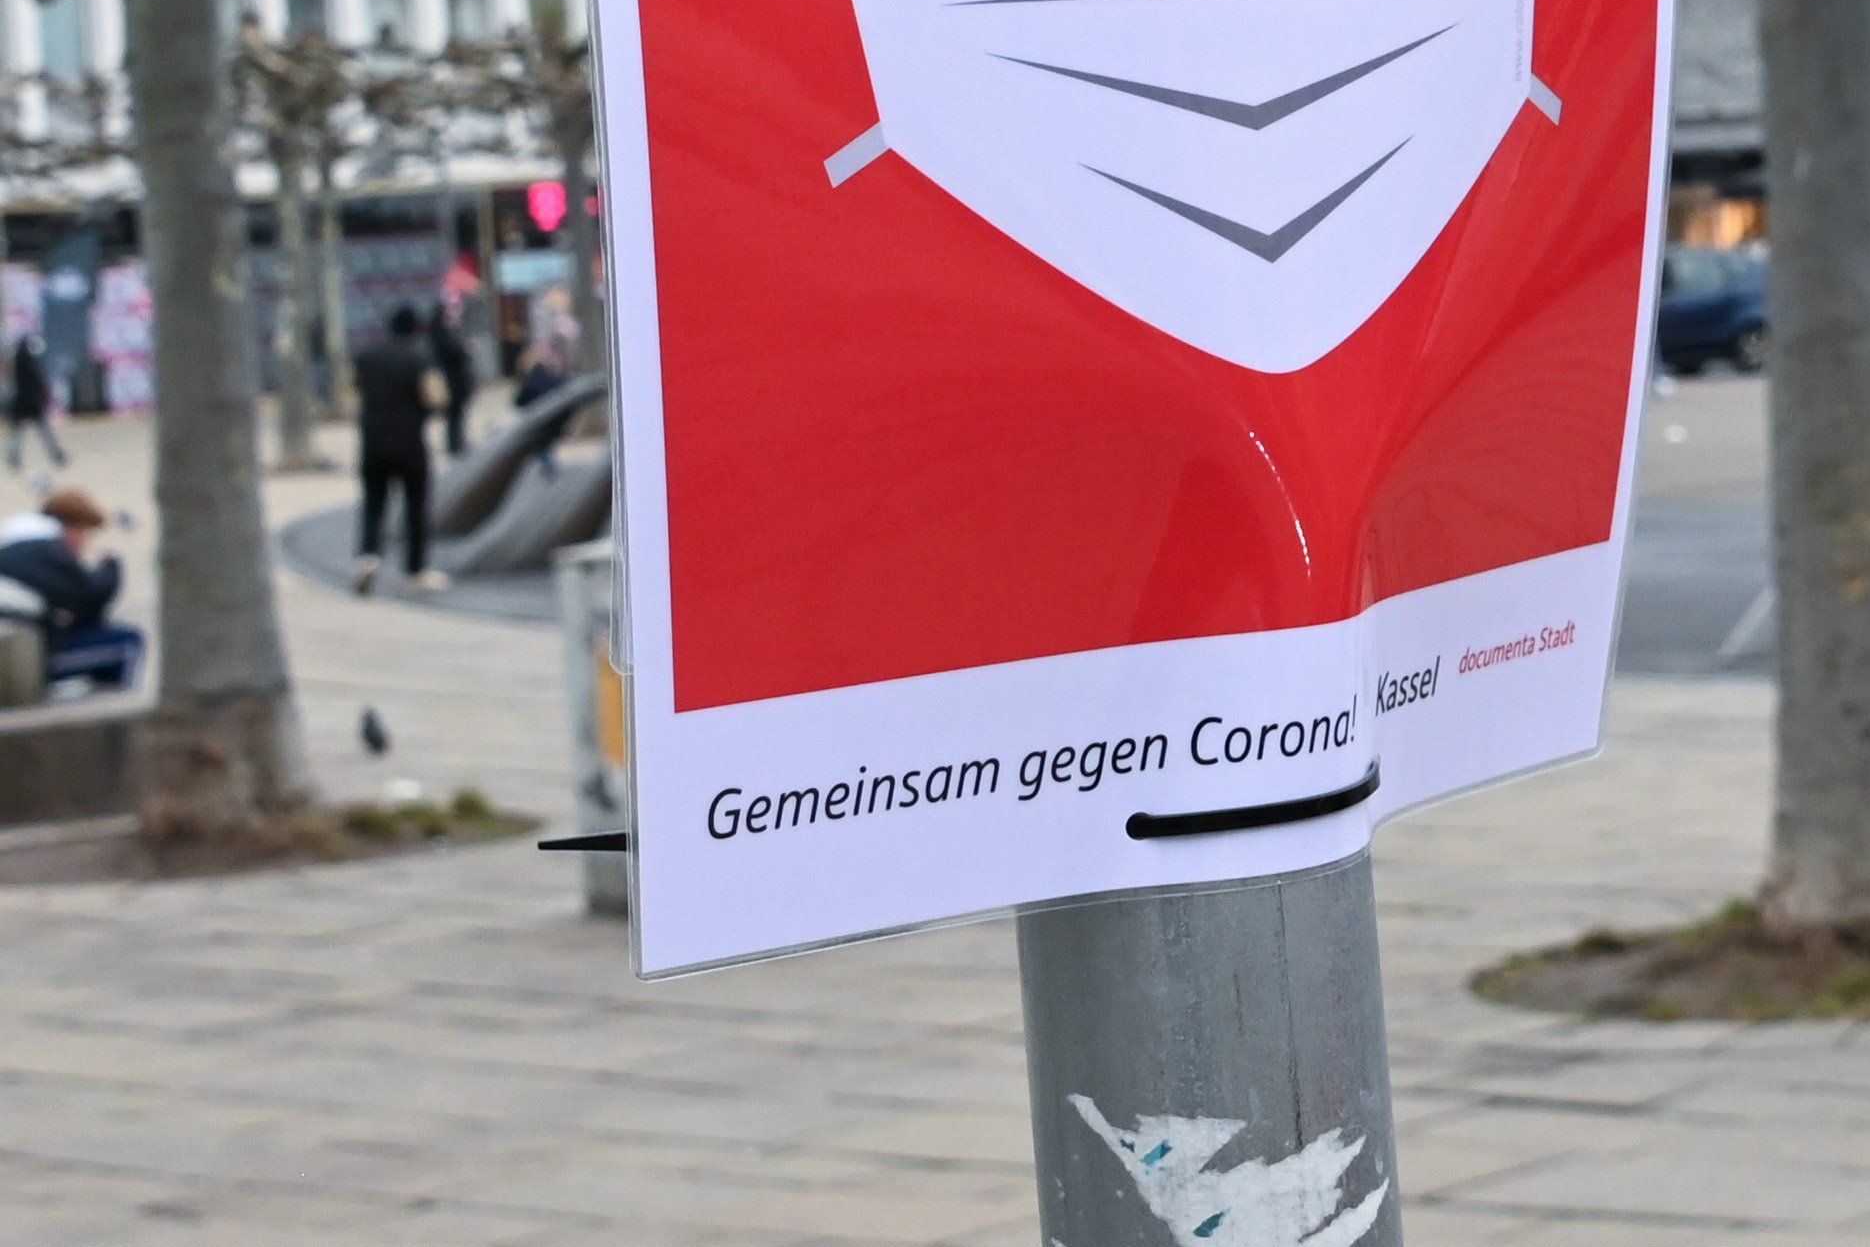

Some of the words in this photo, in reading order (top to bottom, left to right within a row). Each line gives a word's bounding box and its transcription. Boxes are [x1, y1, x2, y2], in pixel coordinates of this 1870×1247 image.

[1375, 655, 1441, 717] Kassel
[1458, 636, 1536, 674] documenta
[1538, 620, 1576, 652] Stadt
[707, 757, 1000, 840] Gemeinsam
[1017, 734, 1169, 802] gegen
[1190, 693, 1357, 766] Corona!
